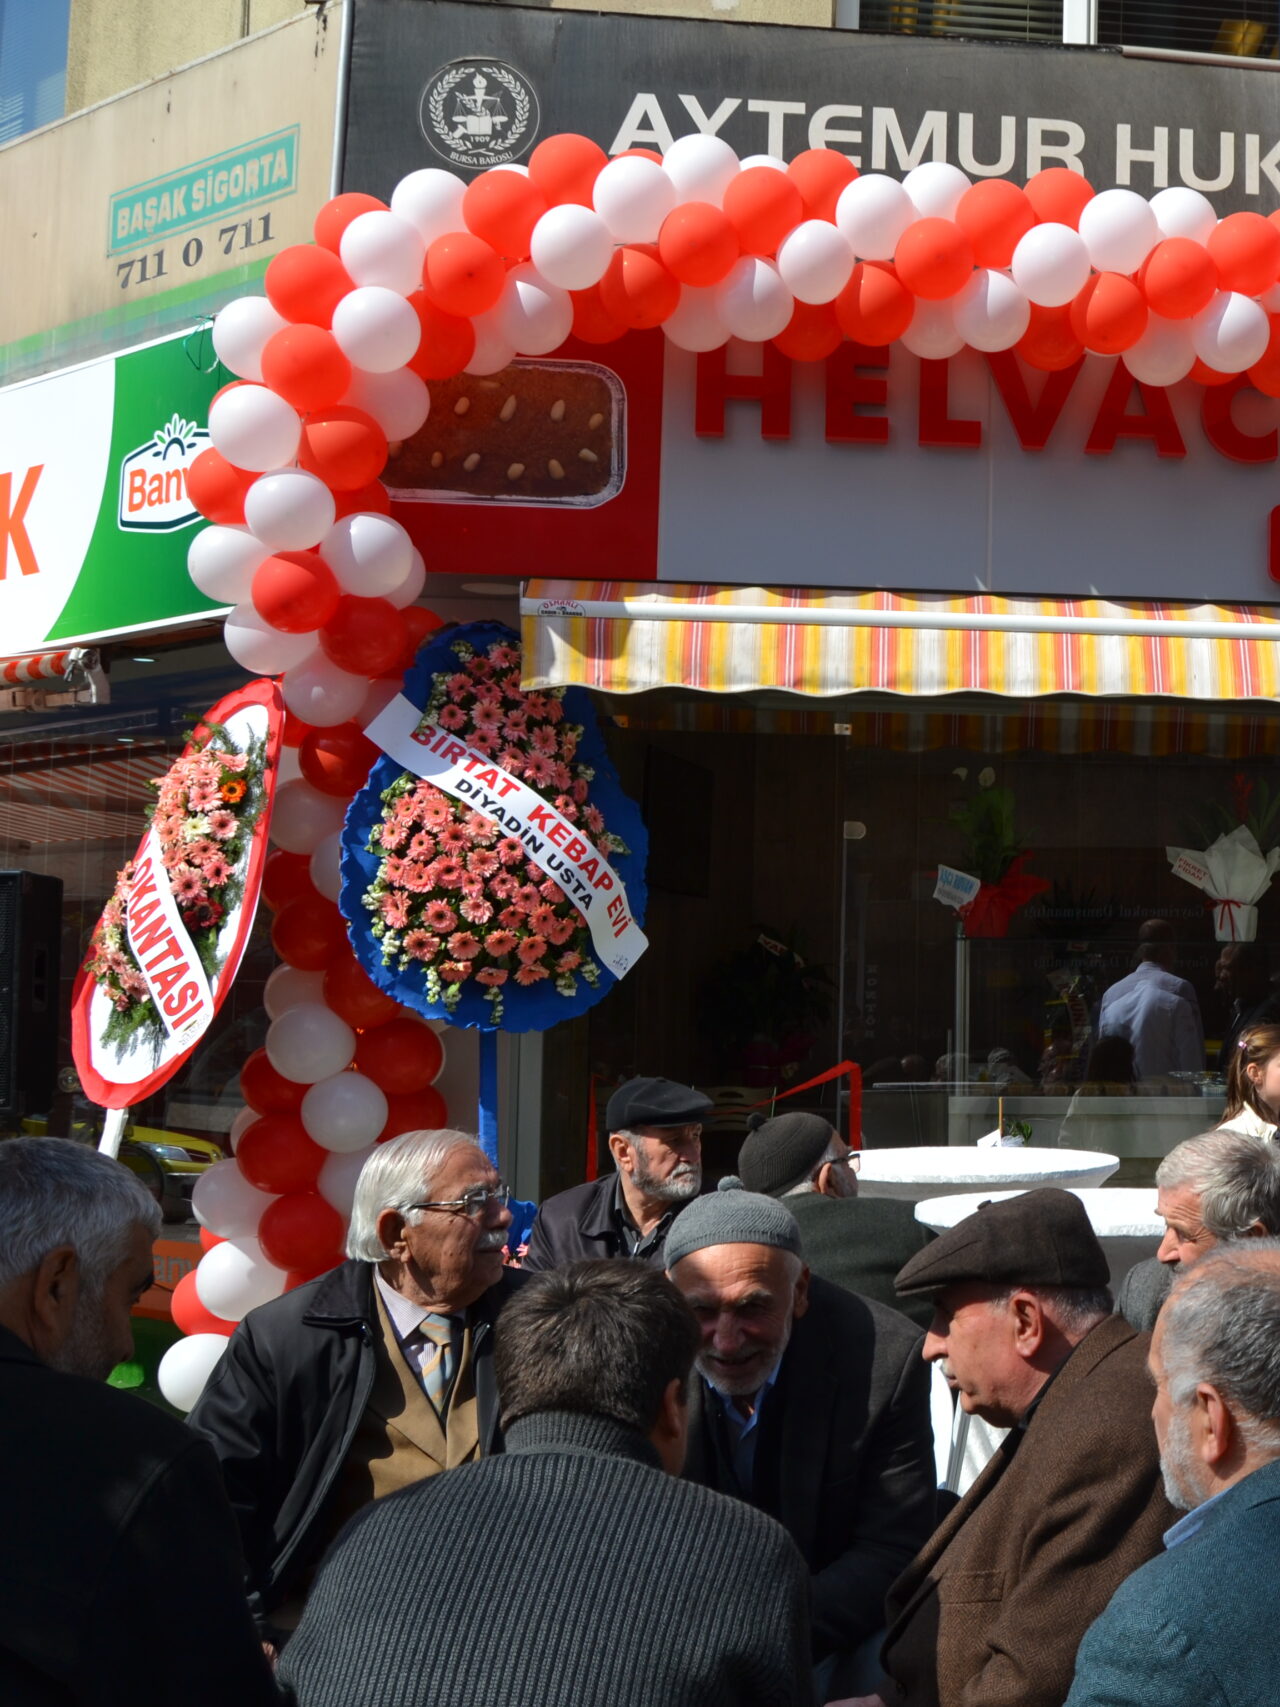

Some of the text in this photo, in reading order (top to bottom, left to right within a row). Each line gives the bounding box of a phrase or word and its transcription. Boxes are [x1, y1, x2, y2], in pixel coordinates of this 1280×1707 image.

[450, 151, 513, 165] BURSA BAROSU
[608, 92, 1086, 180] AYTEMUR
[117, 148, 289, 240] BAŞAK SİGORTA
[116, 212, 275, 289] 711 0 711
[410, 725, 634, 938] BİRTAT KEBAP EVİ
[454, 778, 594, 912] DİYADİN USTA
[128, 843, 204, 1030] OKANTASI
